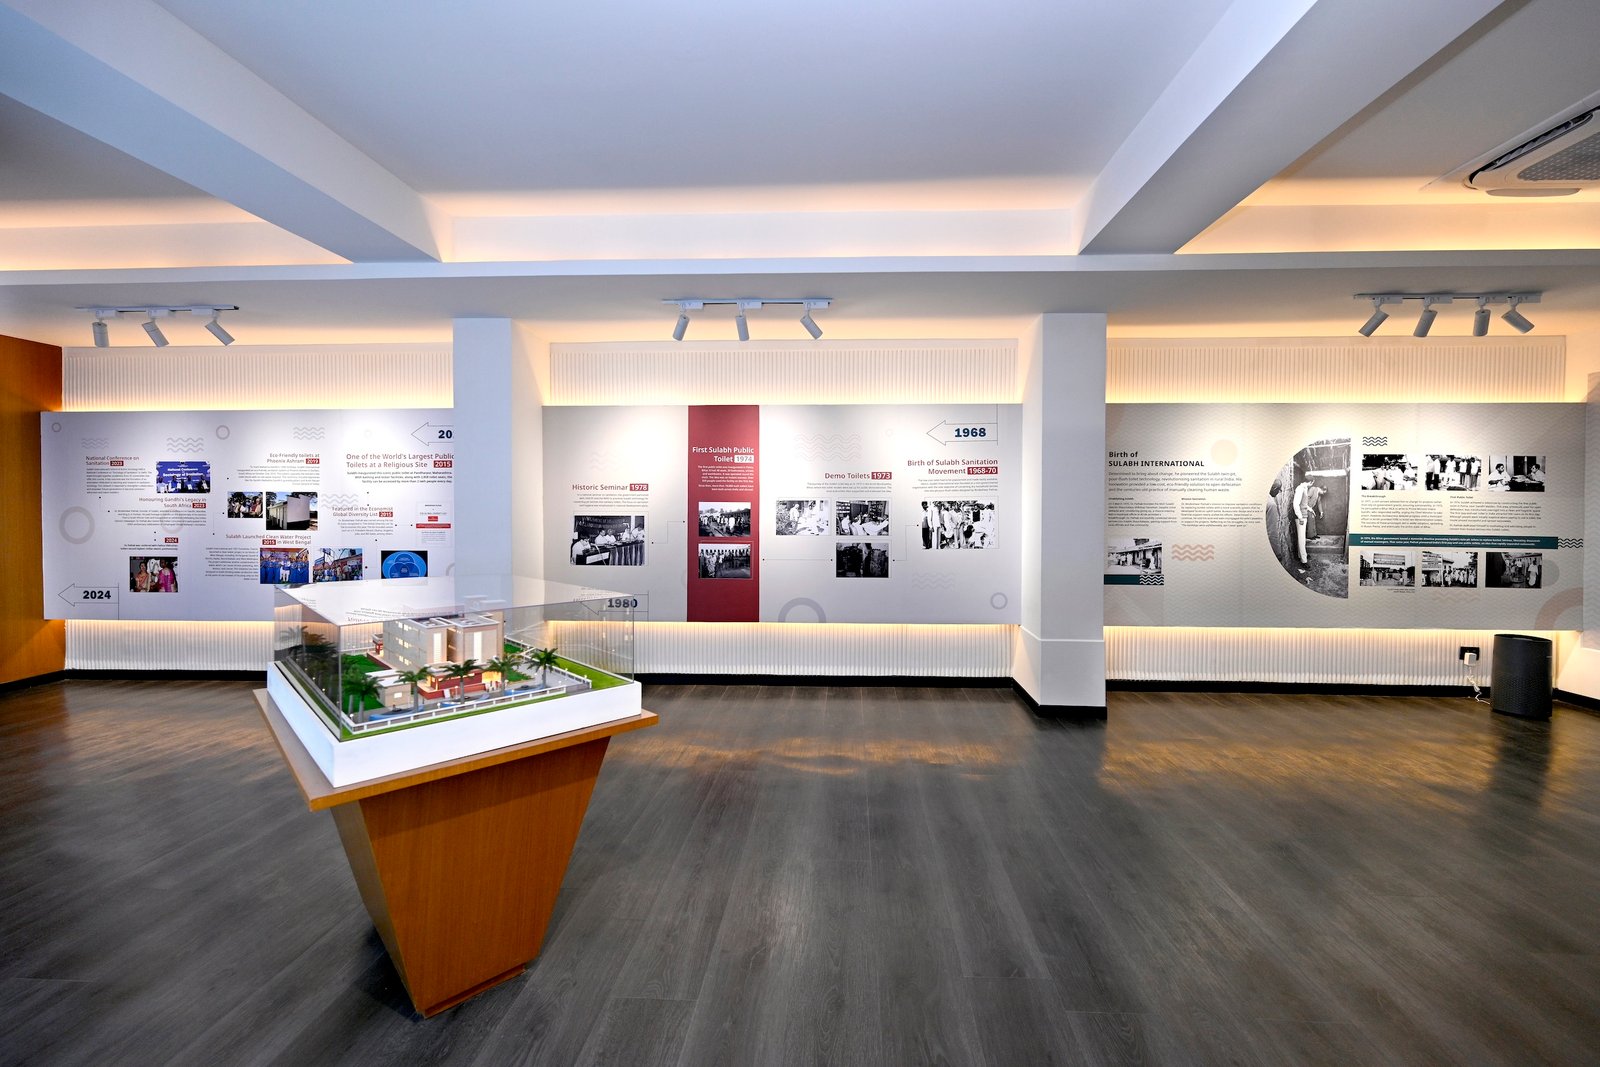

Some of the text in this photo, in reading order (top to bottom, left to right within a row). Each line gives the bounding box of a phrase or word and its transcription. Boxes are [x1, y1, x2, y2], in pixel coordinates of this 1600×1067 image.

[438, 429, 454, 439] 20
[955, 428, 987, 438] 1968
[384, 461, 414, 469] Religious
[83, 590, 111, 599] 2024
[608, 598, 638, 608] 1980
